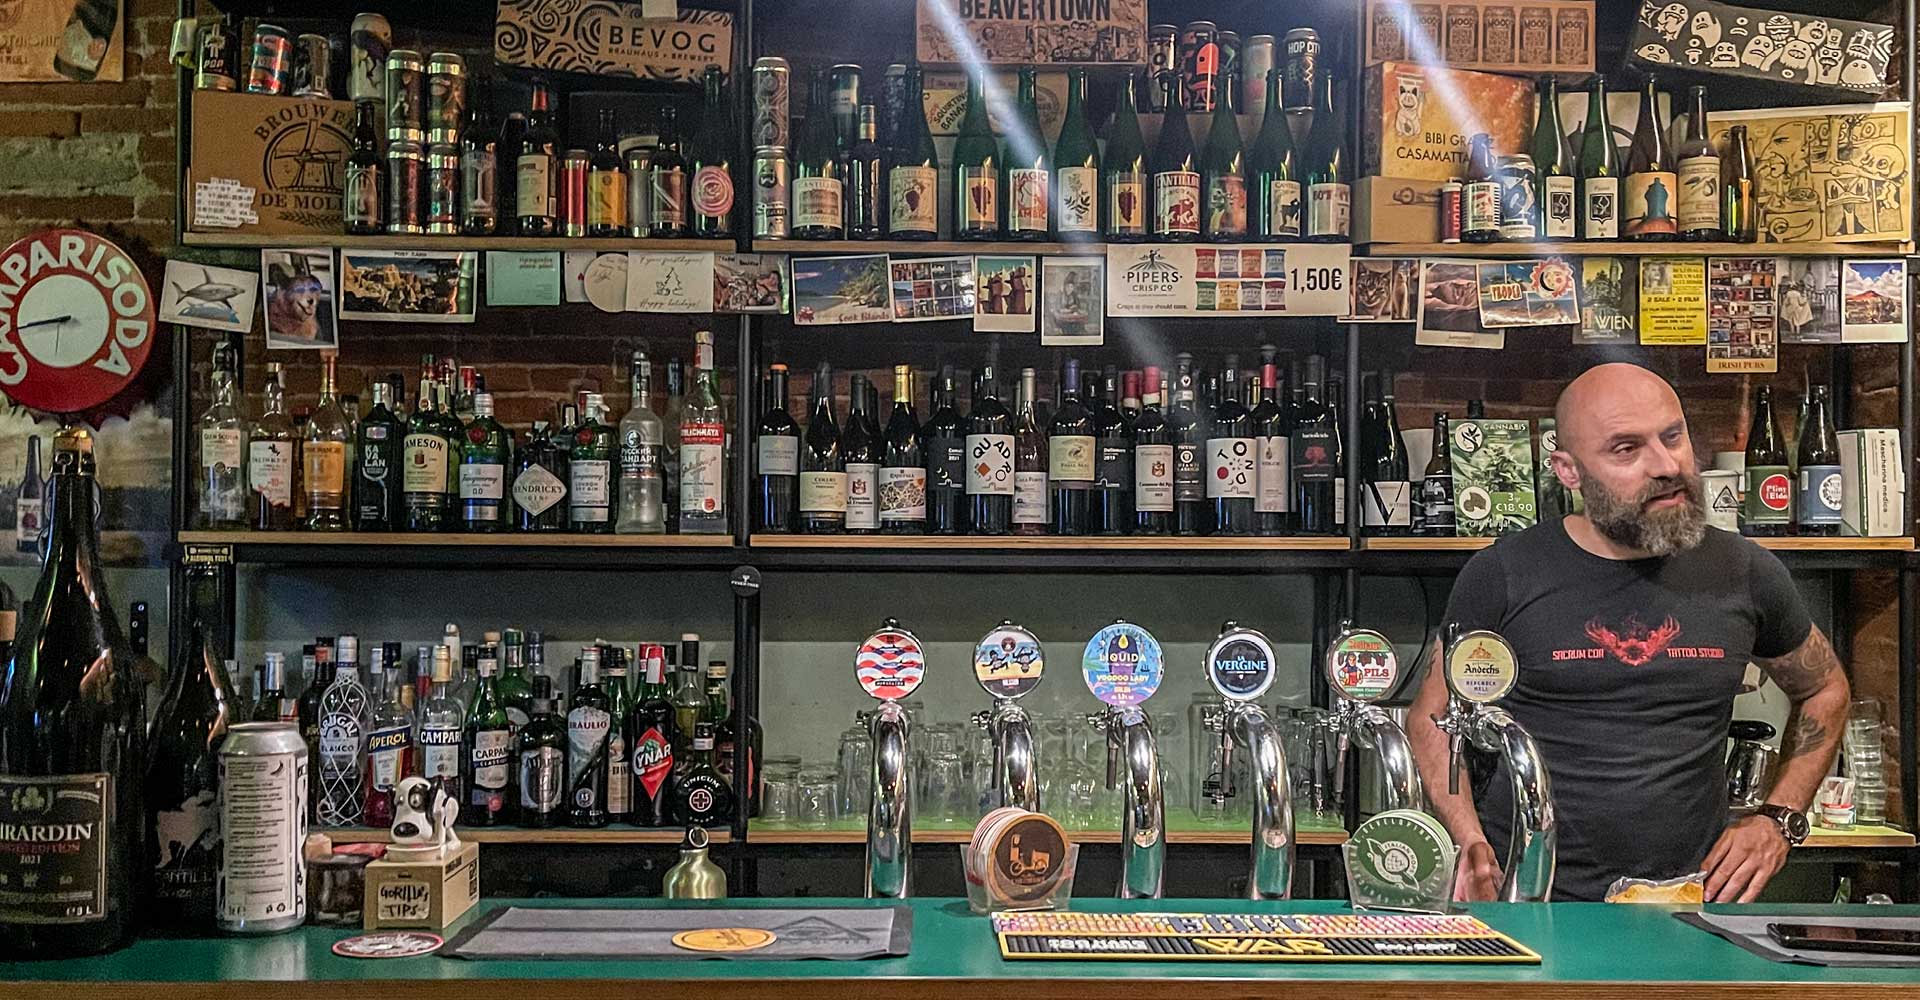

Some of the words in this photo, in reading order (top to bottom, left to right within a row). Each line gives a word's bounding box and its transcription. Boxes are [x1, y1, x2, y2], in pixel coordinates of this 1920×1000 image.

[609, 25, 715, 53] BEVOG
[1288, 41, 1303, 55] HOP
[608, 48, 659, 58] BRAUHAUS
[672, 53, 715, 62] BREWERY
[1425, 132, 1446, 144] BIBI
[1012, 171, 1048, 182] MAGIC
[260, 193, 287, 208] DE
[1127, 271, 1179, 283] PIPERS
[1291, 268, 1342, 294] 1,50€
[1132, 284, 1159, 292] CRISP
[1594, 315, 1634, 330] WIEN
[1718, 361, 1742, 369] IRISH
[1743, 361, 1765, 369] PUBS
[1483, 423, 1526, 431] CANNABIS
[364, 445, 379, 453] KA
[404, 438, 444, 451] AMESON
[1766, 485, 1787, 493] Pliny
[1879, 485, 1888, 513] medica
[1552, 649, 1586, 660] SACRUM
[1667, 647, 1697, 658] TATTOO
[1698, 647, 1724, 658] STUDIO
[1216, 660, 1267, 671] VERGINE
[1463, 663, 1500, 675] Andechs
[1096, 668, 1129, 677] VOODOO
[1130, 669, 1150, 679] LADY
[1364, 668, 1389, 677] PILS
[369, 733, 407, 751] APEROL
[633, 743, 672, 776] CYNAR
[683, 775, 721, 788] UNICUM
[20, 855, 41, 864] 2021
[385, 904, 418, 917] TIPS
